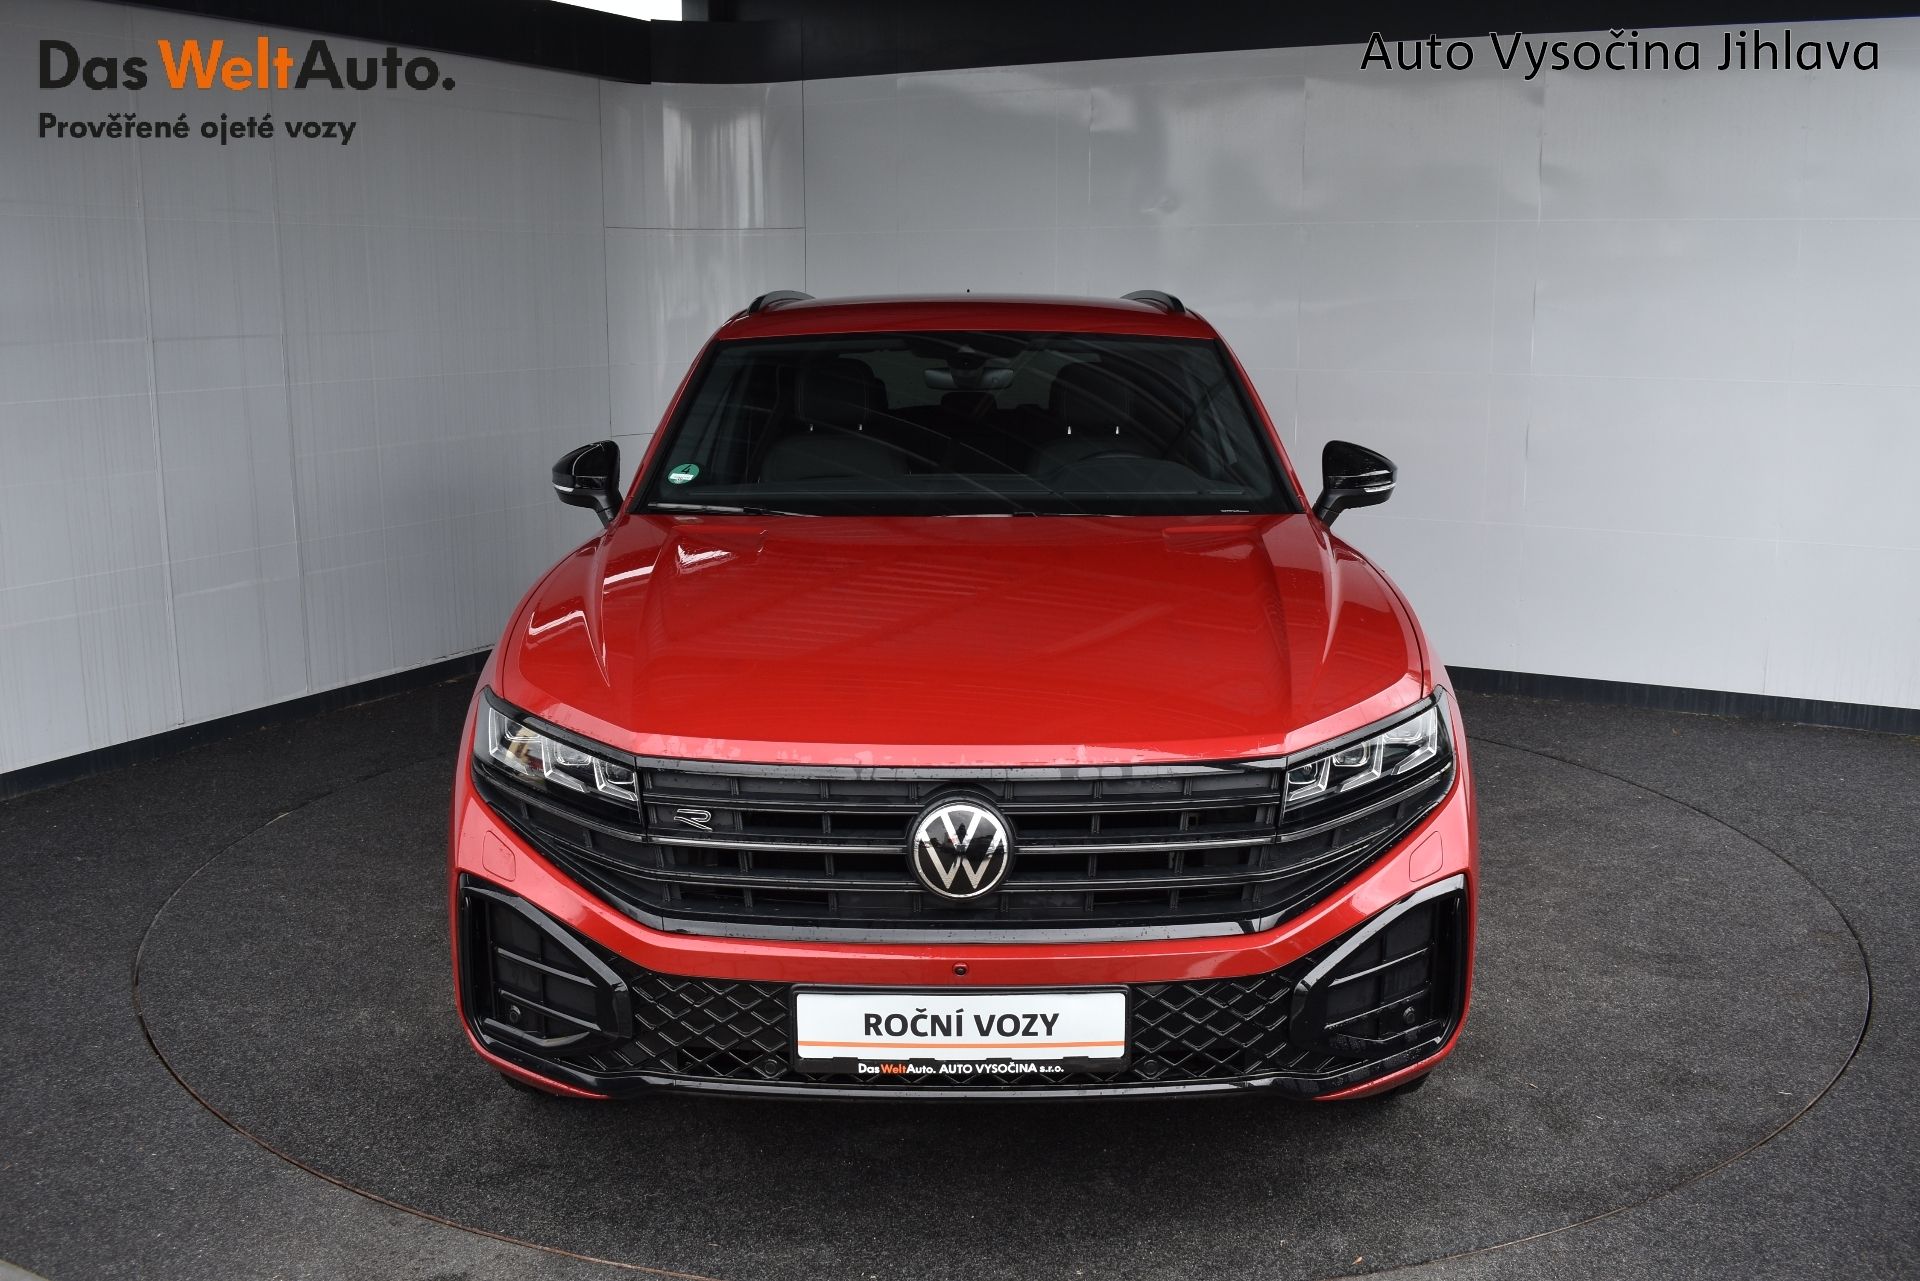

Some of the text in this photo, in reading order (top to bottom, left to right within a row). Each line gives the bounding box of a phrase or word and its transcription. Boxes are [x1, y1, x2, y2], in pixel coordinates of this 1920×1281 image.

[863, 1007, 1060, 1037] ROČNÍ VOZY
[857, 1062, 881, 1074] Das
[939, 1063, 973, 1074] AUTO
[975, 1061, 1038, 1074] VYSOČINA
[1039, 1064, 1065, 1073] s.r.o.
